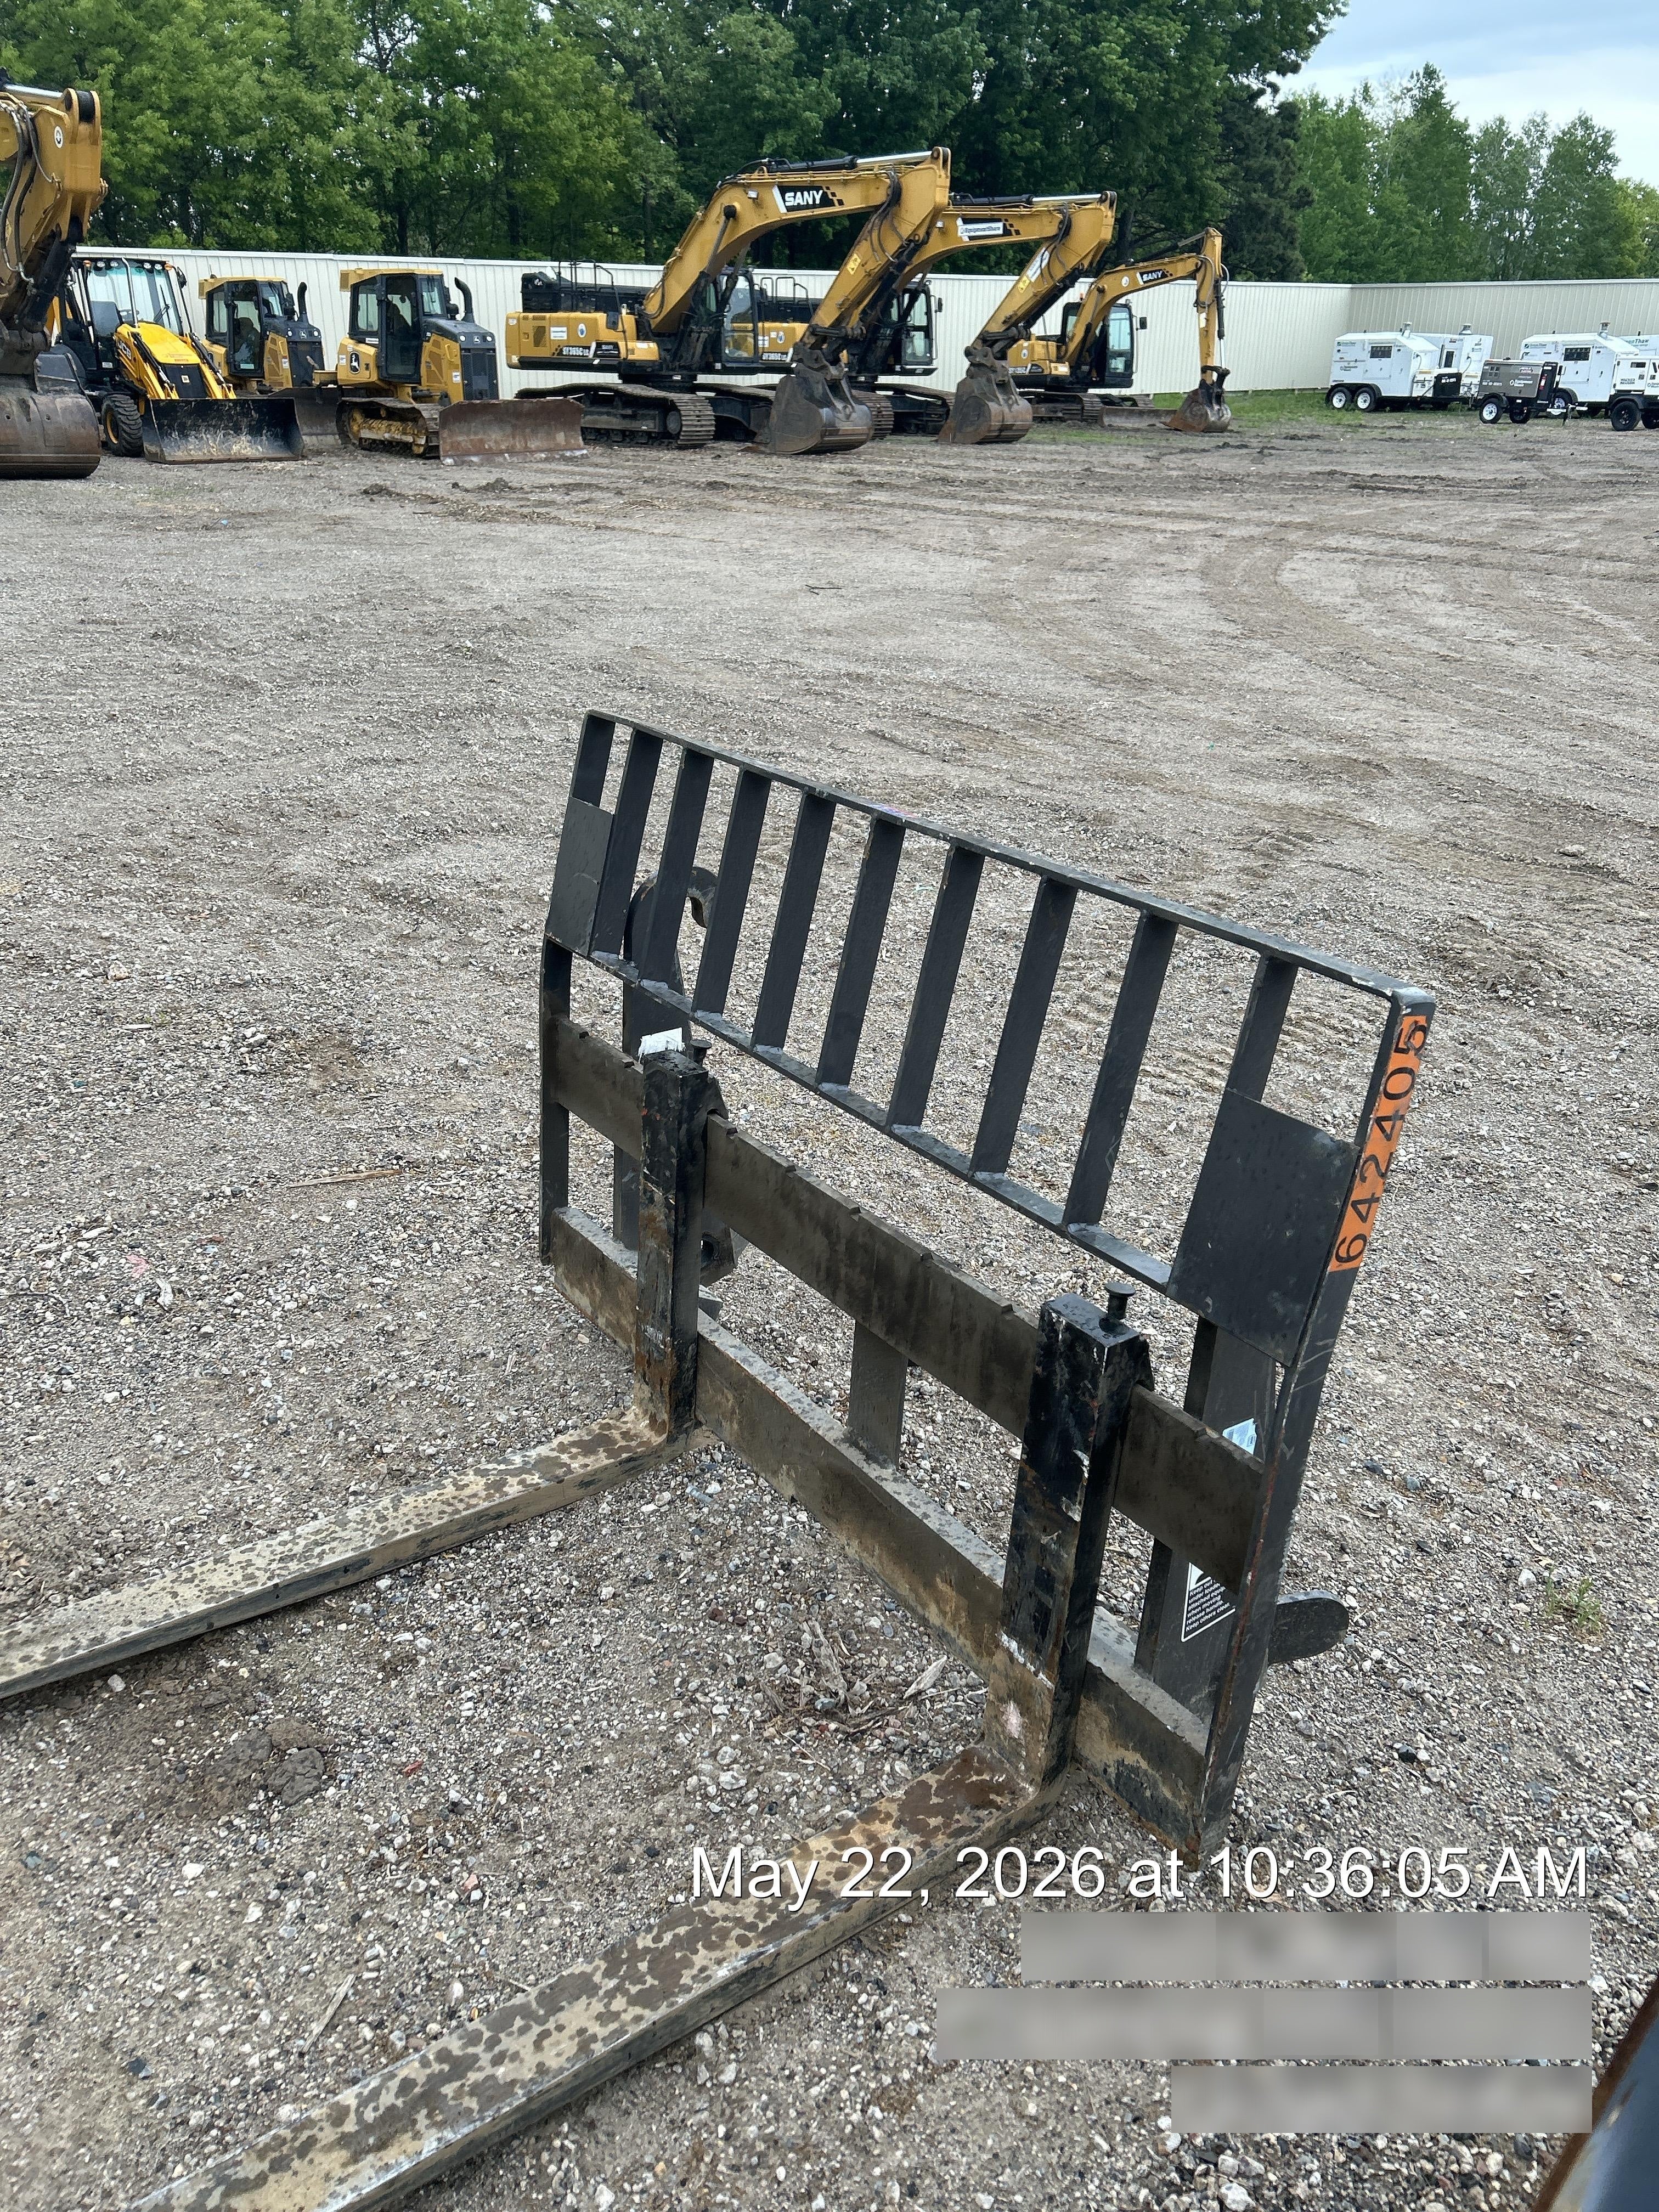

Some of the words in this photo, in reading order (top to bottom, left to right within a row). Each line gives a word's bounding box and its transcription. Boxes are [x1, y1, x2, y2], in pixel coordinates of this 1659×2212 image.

[785, 190, 823, 206] SANY
[1142, 270, 1163, 281] SANY
[117, 340, 132, 360] JCB
[1335, 1019, 1427, 1264] 642405
